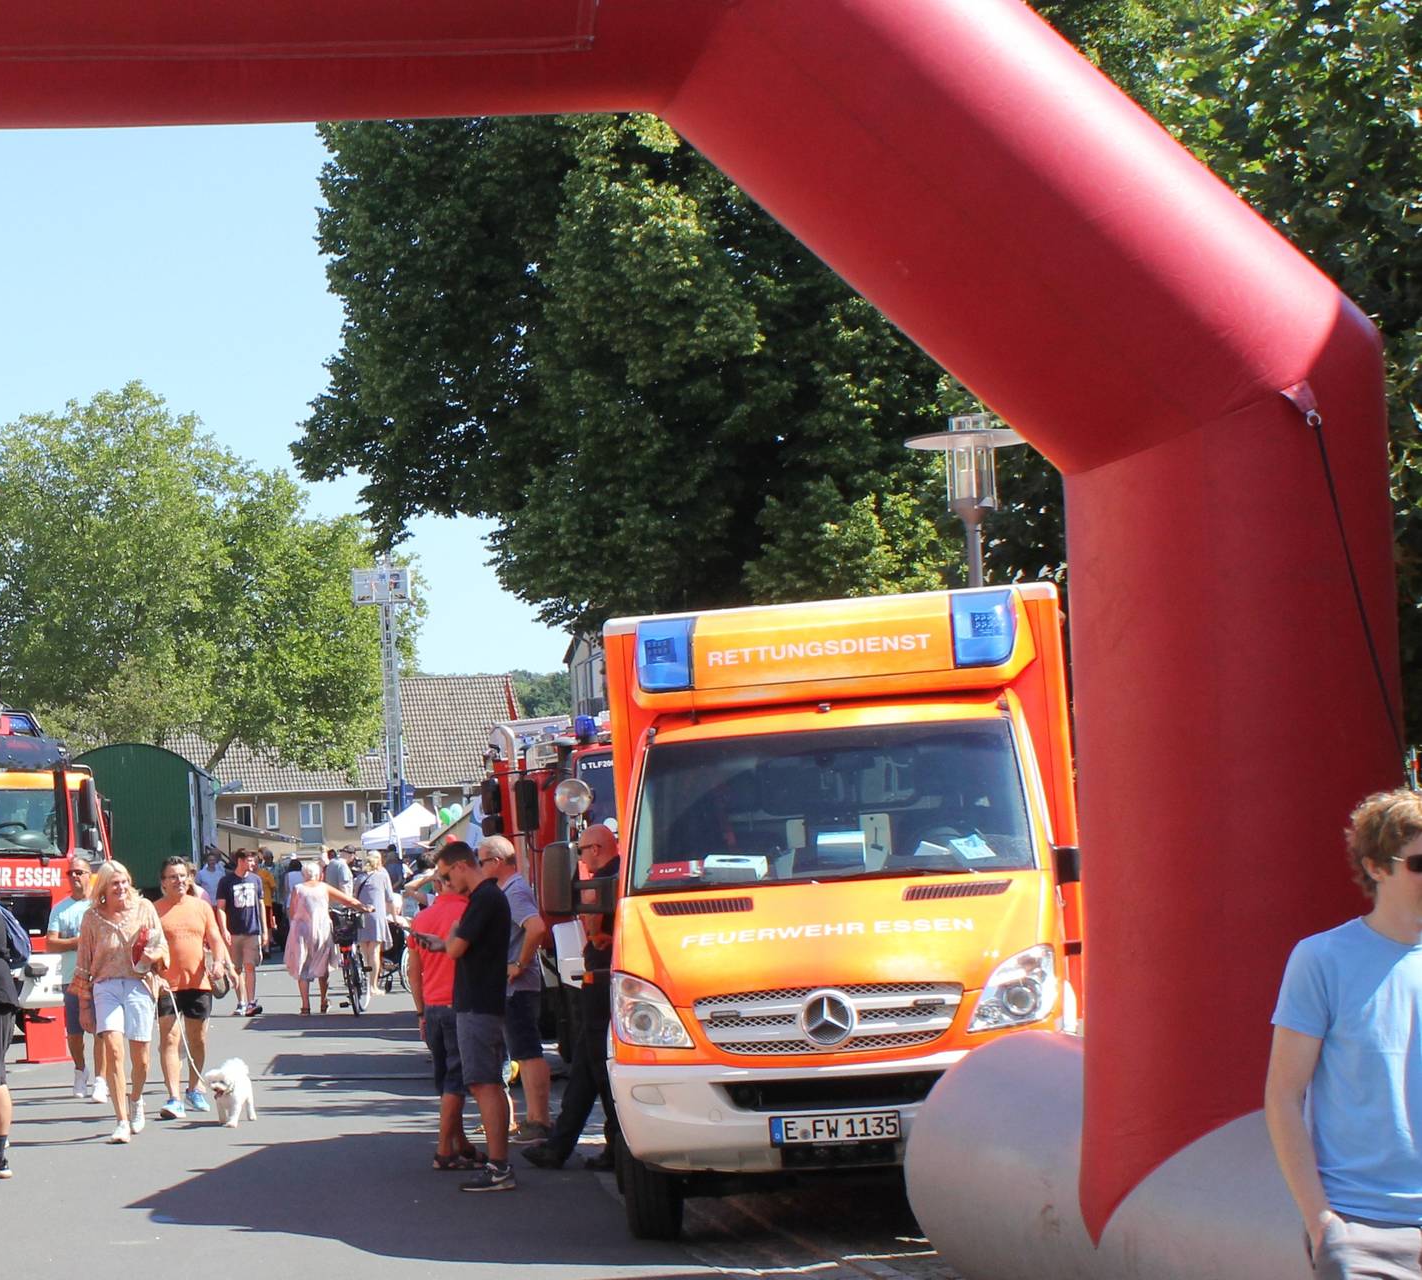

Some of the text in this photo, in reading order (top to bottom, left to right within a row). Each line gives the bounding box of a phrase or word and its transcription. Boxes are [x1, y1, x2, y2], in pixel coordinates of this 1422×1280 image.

[707, 633, 931, 667] RETTUNGSDIENST
[15, 866, 61, 888] ESSEN
[682, 918, 974, 948] FEUERWEHR ESSEN
[812, 1119, 839, 1138] FW
[845, 1115, 898, 1137] 1135
